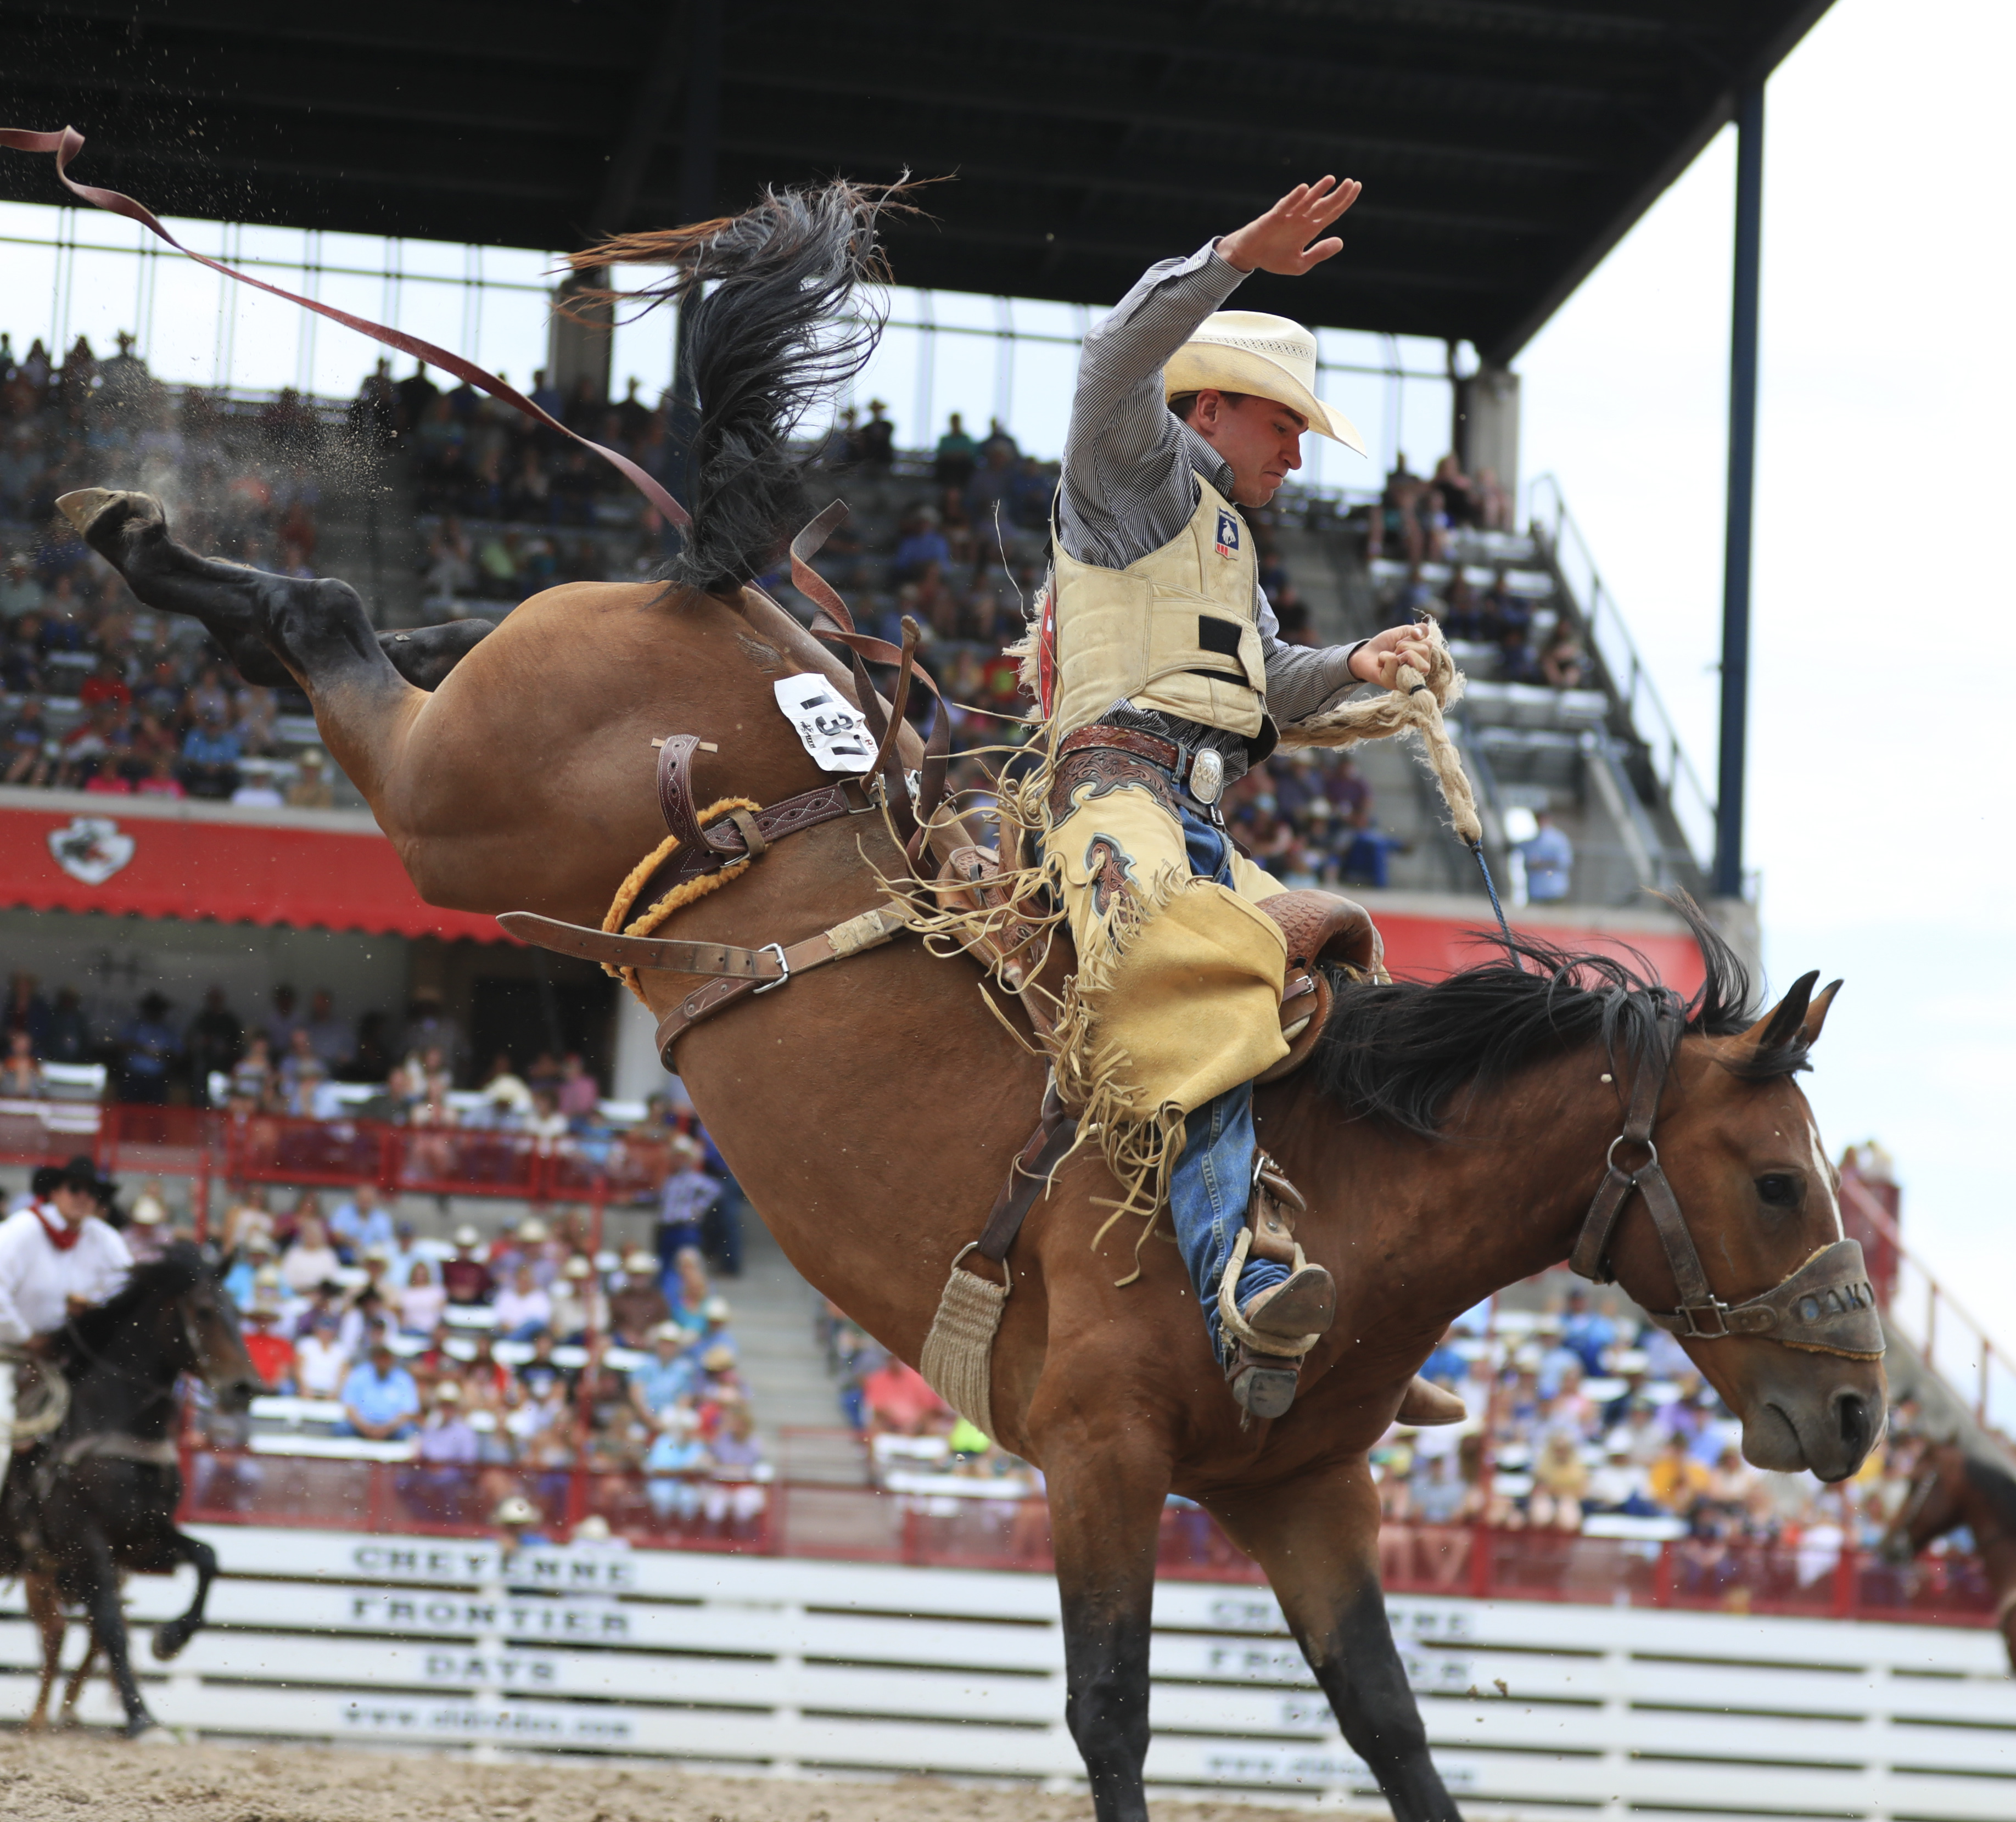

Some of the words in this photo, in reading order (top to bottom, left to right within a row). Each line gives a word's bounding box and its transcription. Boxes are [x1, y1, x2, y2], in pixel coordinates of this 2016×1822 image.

[800, 689, 870, 756] 137
[355, 1546, 632, 1583] CHEYENNE
[352, 1598, 629, 1633] FRONTIER
[426, 1655, 556, 1682] DAYS
